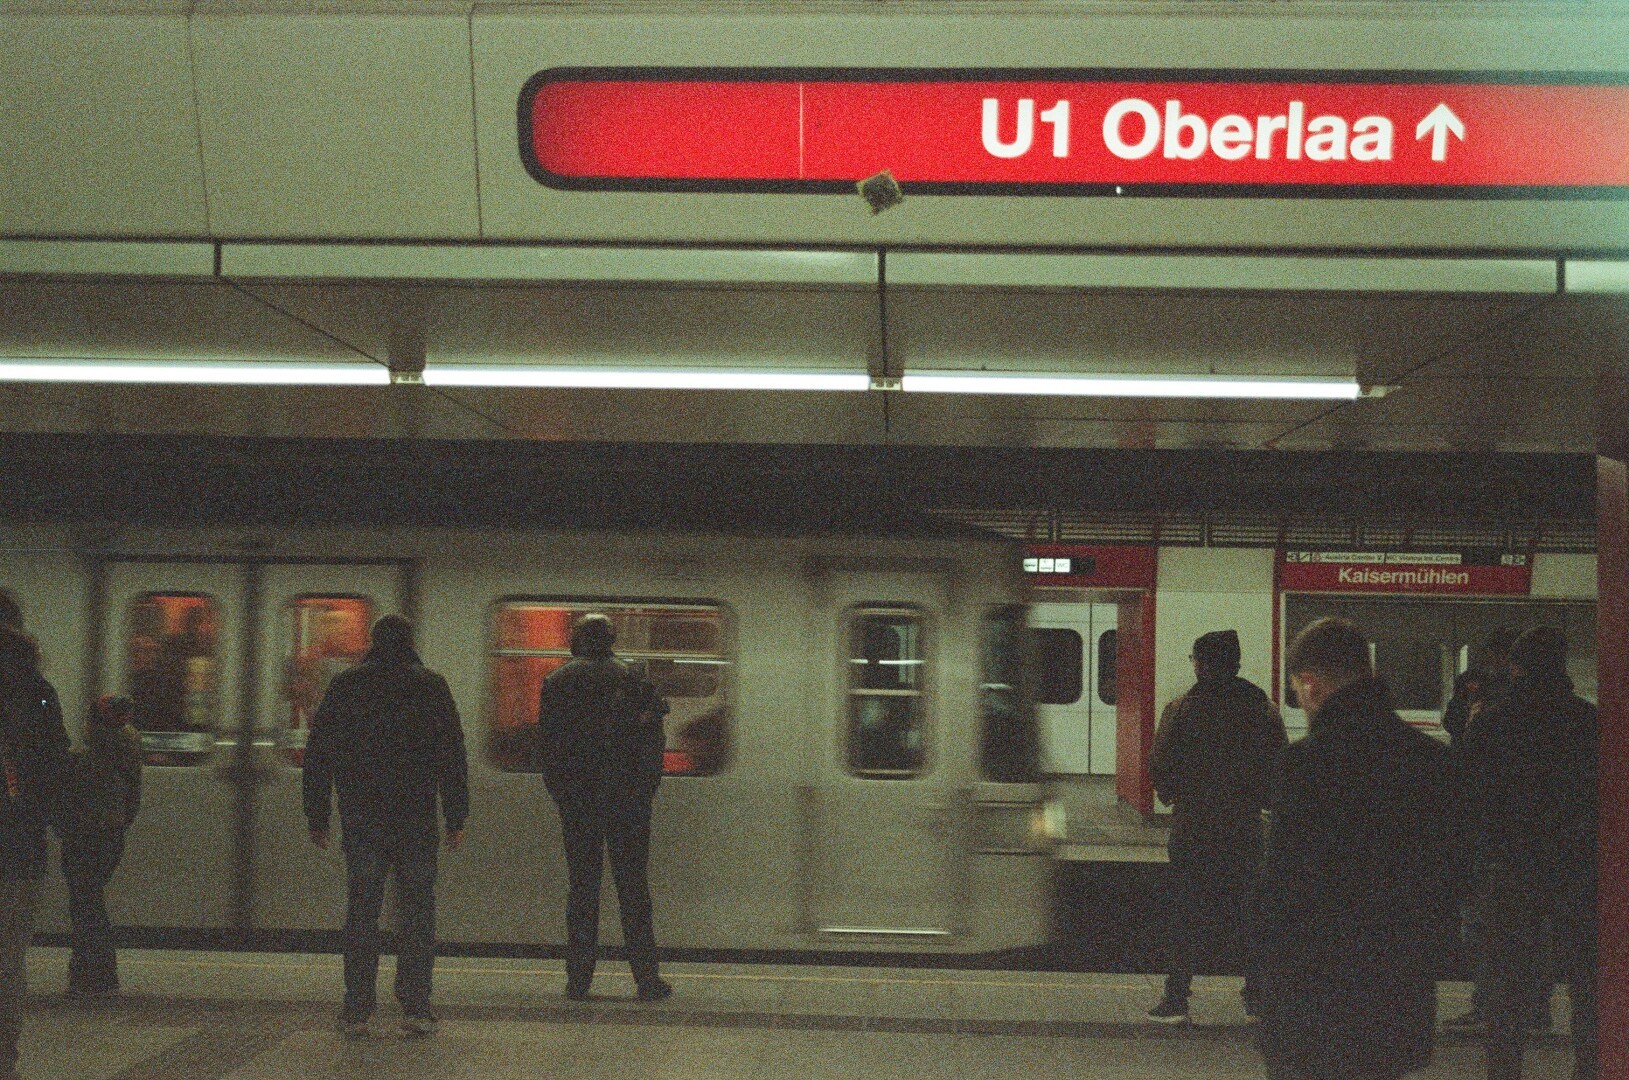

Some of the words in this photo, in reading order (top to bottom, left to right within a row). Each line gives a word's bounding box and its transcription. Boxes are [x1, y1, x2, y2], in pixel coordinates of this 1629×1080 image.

[981, 98, 1070, 159] U1
[1102, 98, 1394, 162] Oberlaa
[1338, 567, 1469, 585] Kaisermühlen
